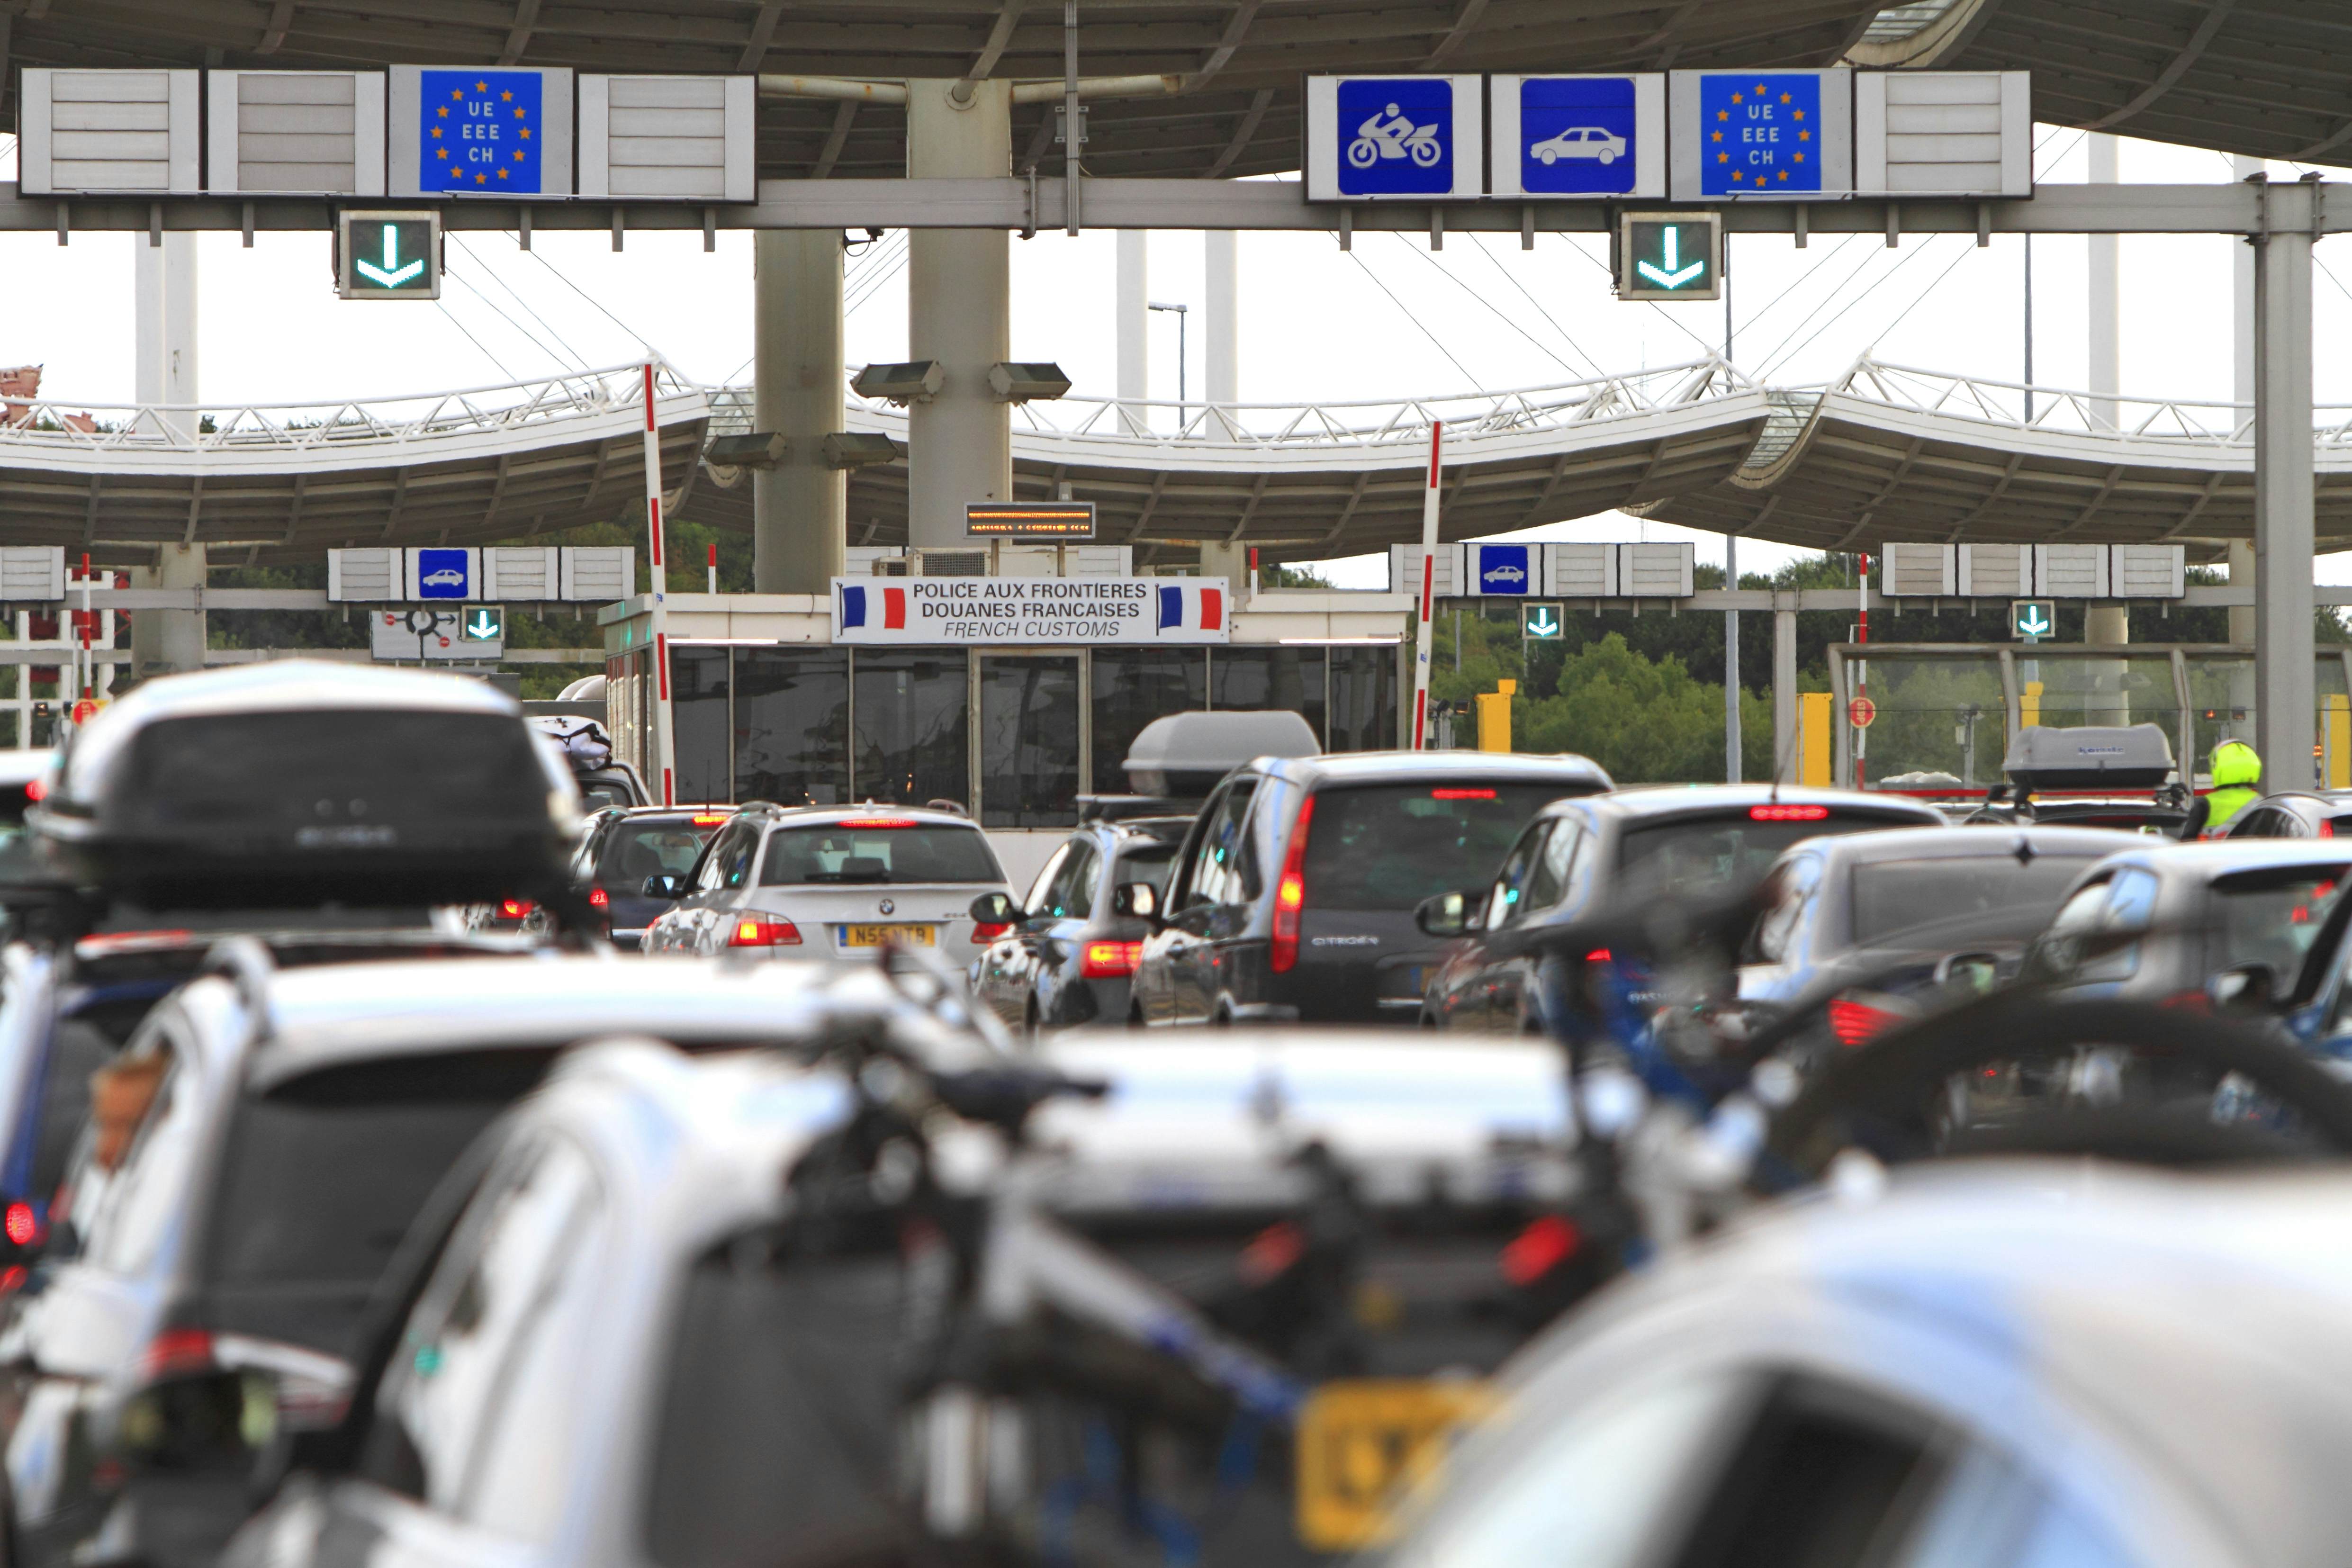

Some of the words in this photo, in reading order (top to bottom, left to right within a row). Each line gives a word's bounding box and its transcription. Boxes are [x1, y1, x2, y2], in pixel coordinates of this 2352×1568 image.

[468, 101, 494, 117] UE
[1748, 104, 1774, 120] UE
[462, 124, 500, 139] EEE
[1742, 127, 1780, 143] EEE
[468, 146, 493, 162] CH
[1749, 150, 1773, 165] CH
[913, 583, 978, 598] POLICE
[984, 583, 1025, 598] AUX
[1031, 583, 1146, 598] FRONTIERES
[922, 603, 1016, 618] DOUANES
[1022, 603, 1140, 617] FRANCAISES
[944, 622, 1019, 638] FRENCH
[1025, 622, 1120, 637] CUSTOMS
